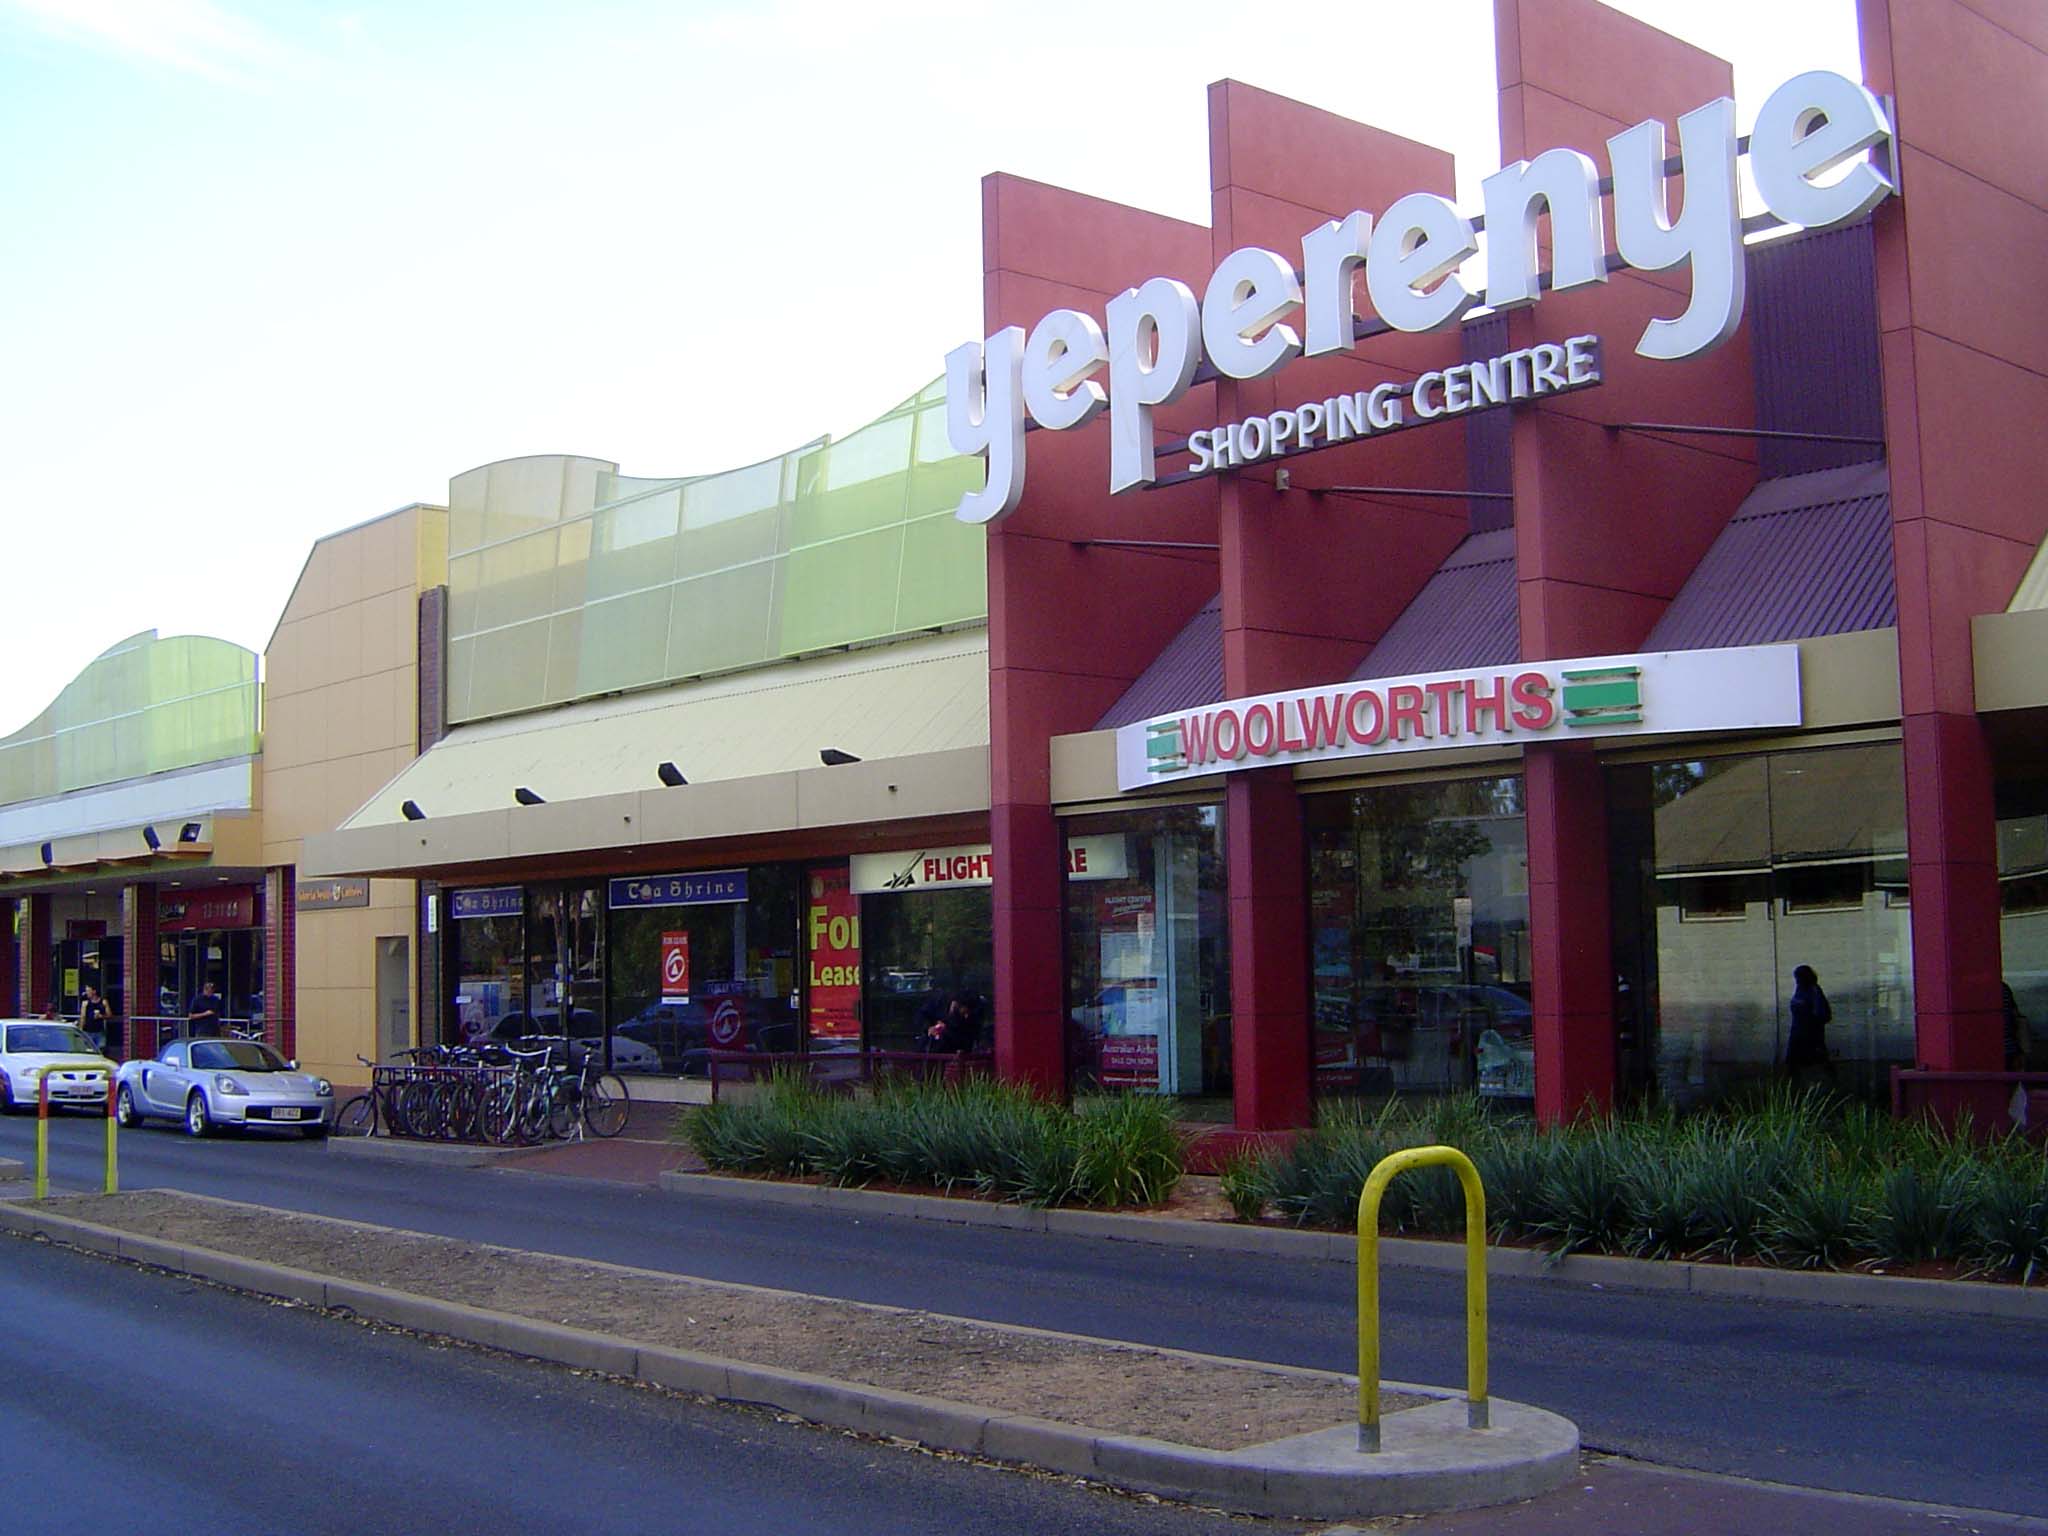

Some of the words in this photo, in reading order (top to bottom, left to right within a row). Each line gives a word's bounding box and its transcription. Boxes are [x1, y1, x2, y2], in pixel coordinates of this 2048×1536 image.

[944, 70, 1893, 523] yeperenye
[1188, 382, 1403, 473] SHOPPING
[1412, 334, 1600, 418] CENTRE
[1179, 672, 1557, 765] WOOLWORTHS
[669, 880, 736, 899] Shrine
[924, 854, 993, 882] FLIGHT
